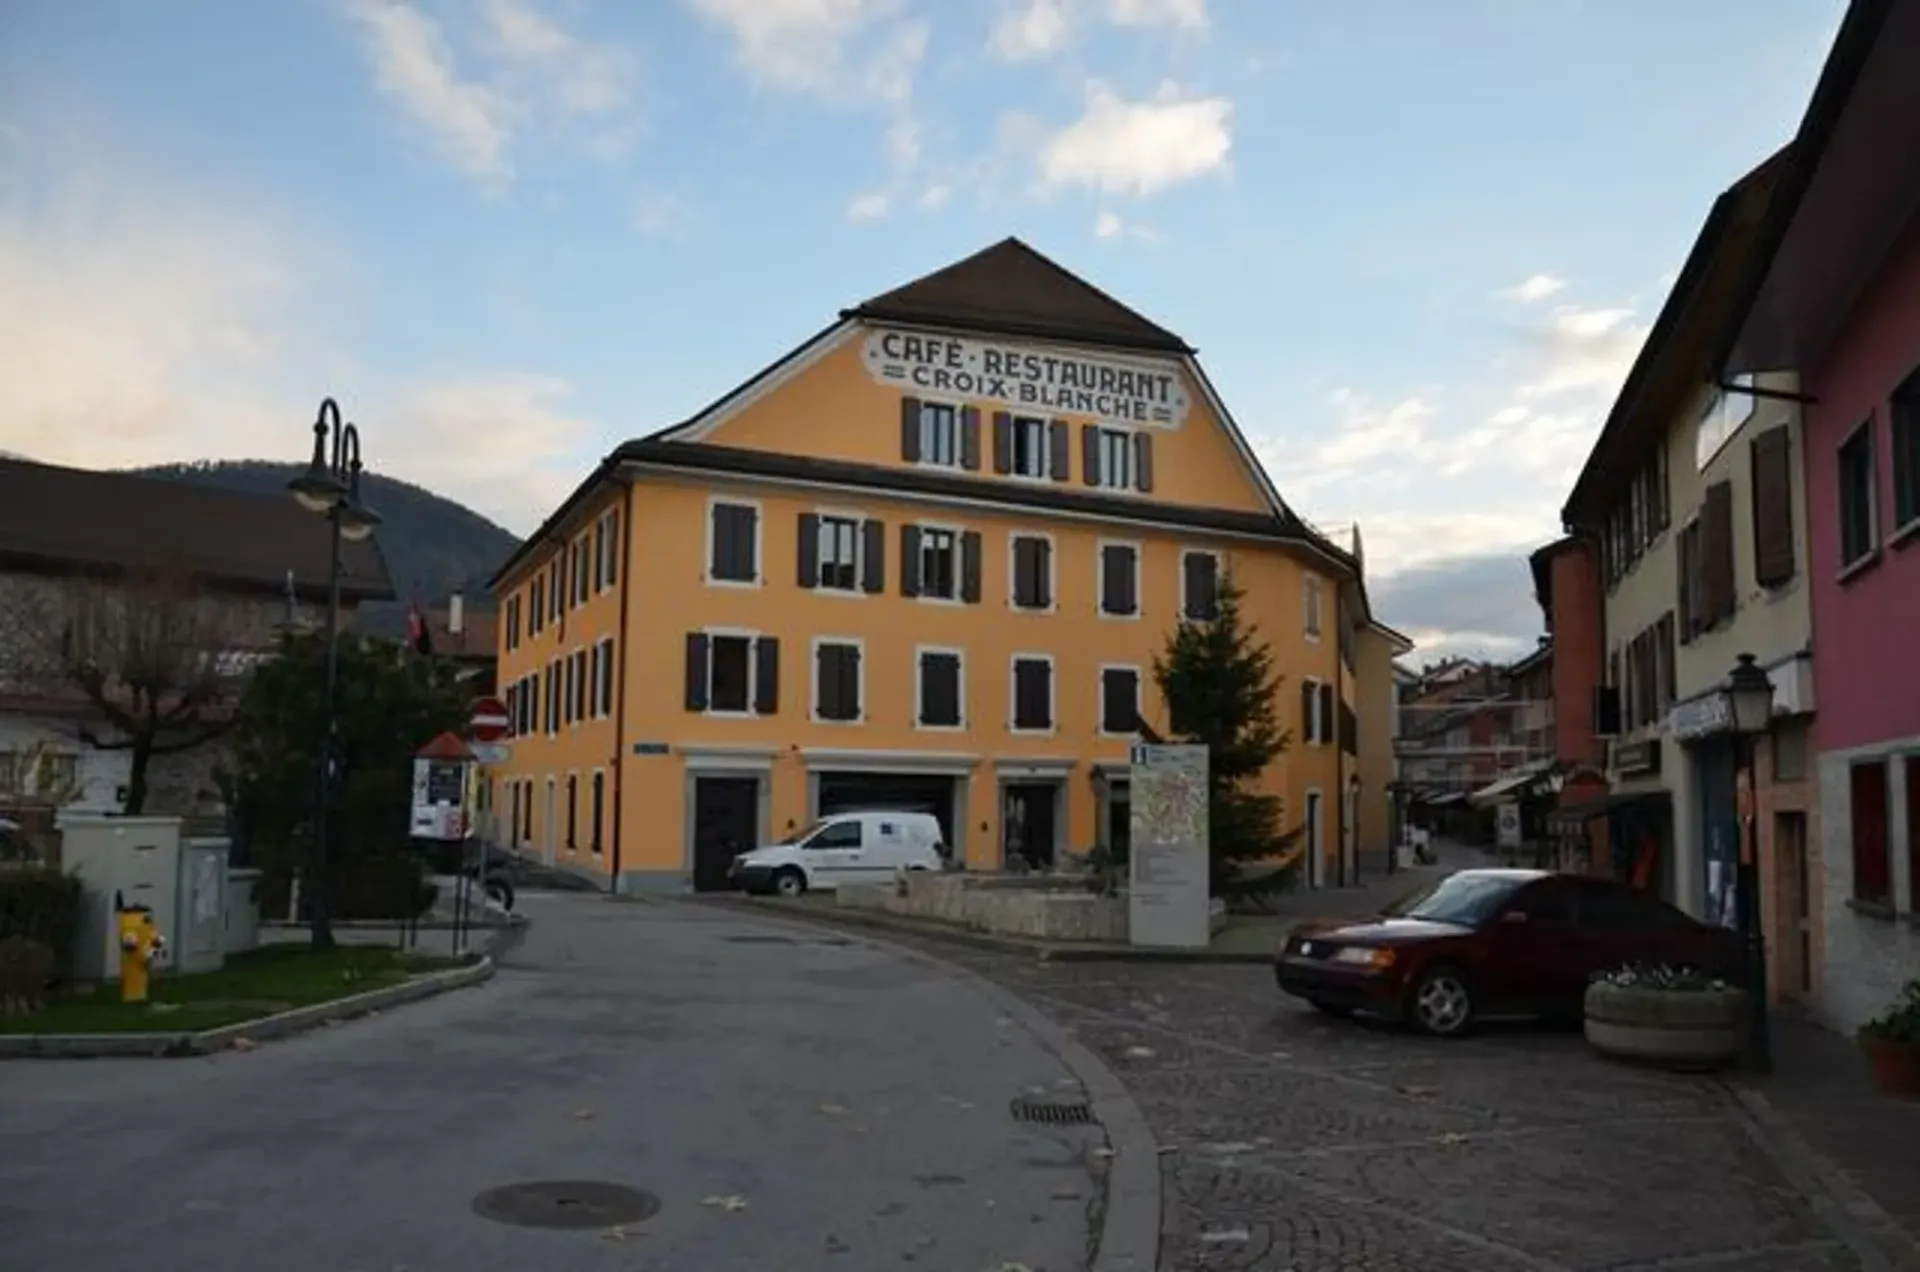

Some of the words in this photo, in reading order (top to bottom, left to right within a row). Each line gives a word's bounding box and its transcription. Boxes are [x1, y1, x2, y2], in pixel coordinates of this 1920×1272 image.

[882, 333, 963, 368] CAFÉ
[984, 349, 1173, 403] RESTAURANT
[912, 366, 1007, 397] CROIX
[1019, 383, 1148, 421] BLANCHE
